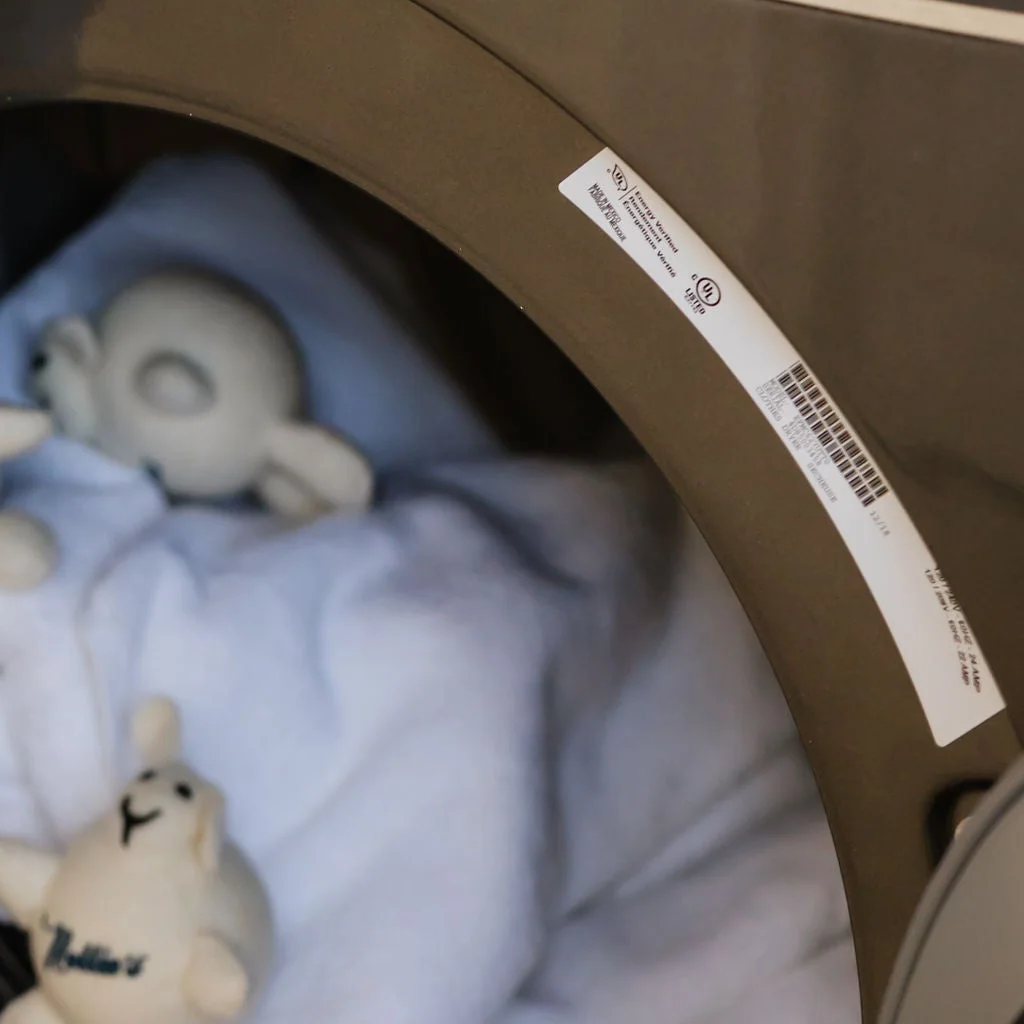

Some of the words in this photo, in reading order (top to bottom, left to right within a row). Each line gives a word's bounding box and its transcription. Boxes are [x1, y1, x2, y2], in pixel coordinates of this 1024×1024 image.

[606, 202, 622, 224] MEXICO
[628, 196, 662, 243] Rendement
[635, 191, 656, 220] Energy
[656, 221, 679, 253] Verified
[685, 287, 706, 315] LISTED
[702, 282, 715, 302] UL
